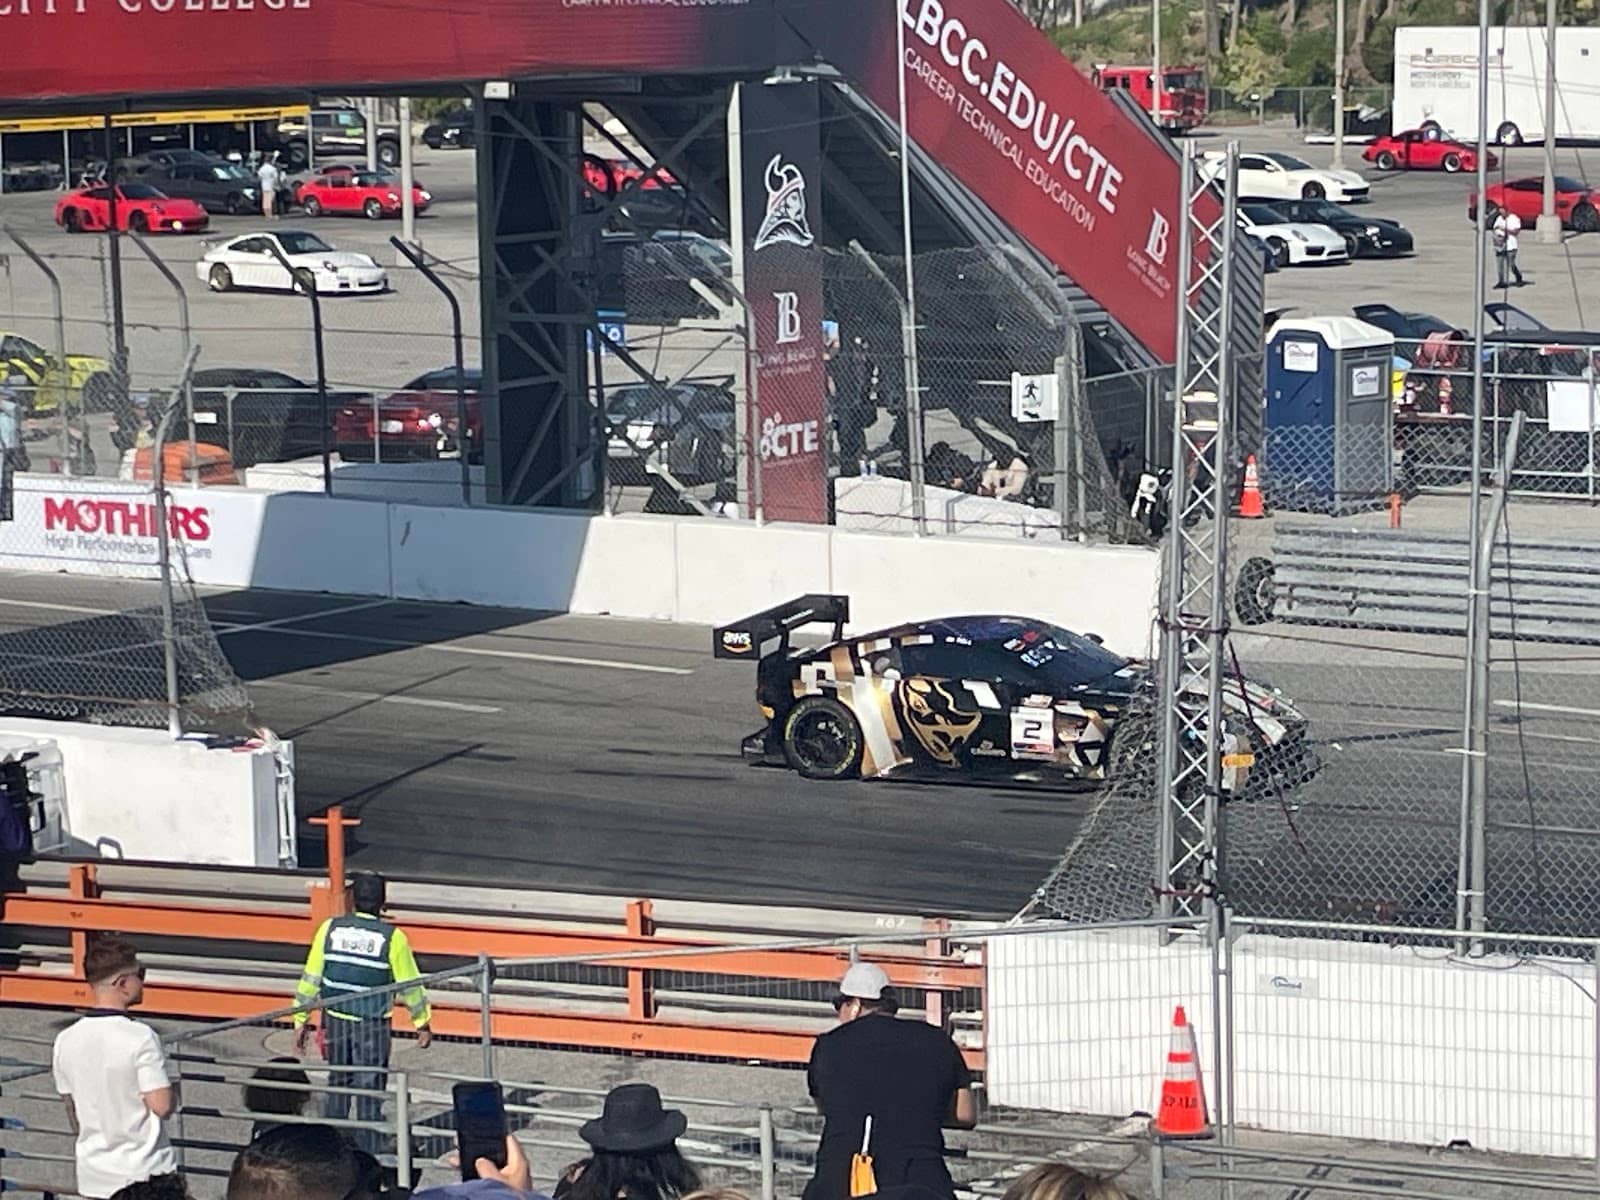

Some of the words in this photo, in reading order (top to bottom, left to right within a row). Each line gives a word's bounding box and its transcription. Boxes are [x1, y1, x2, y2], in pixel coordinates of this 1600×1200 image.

[904, 47, 956, 105] CAREER
[956, 93, 1025, 171] TECHNICAL
[1024, 158, 1096, 233] EDUCATION
[1023, 720, 1043, 739] 2
